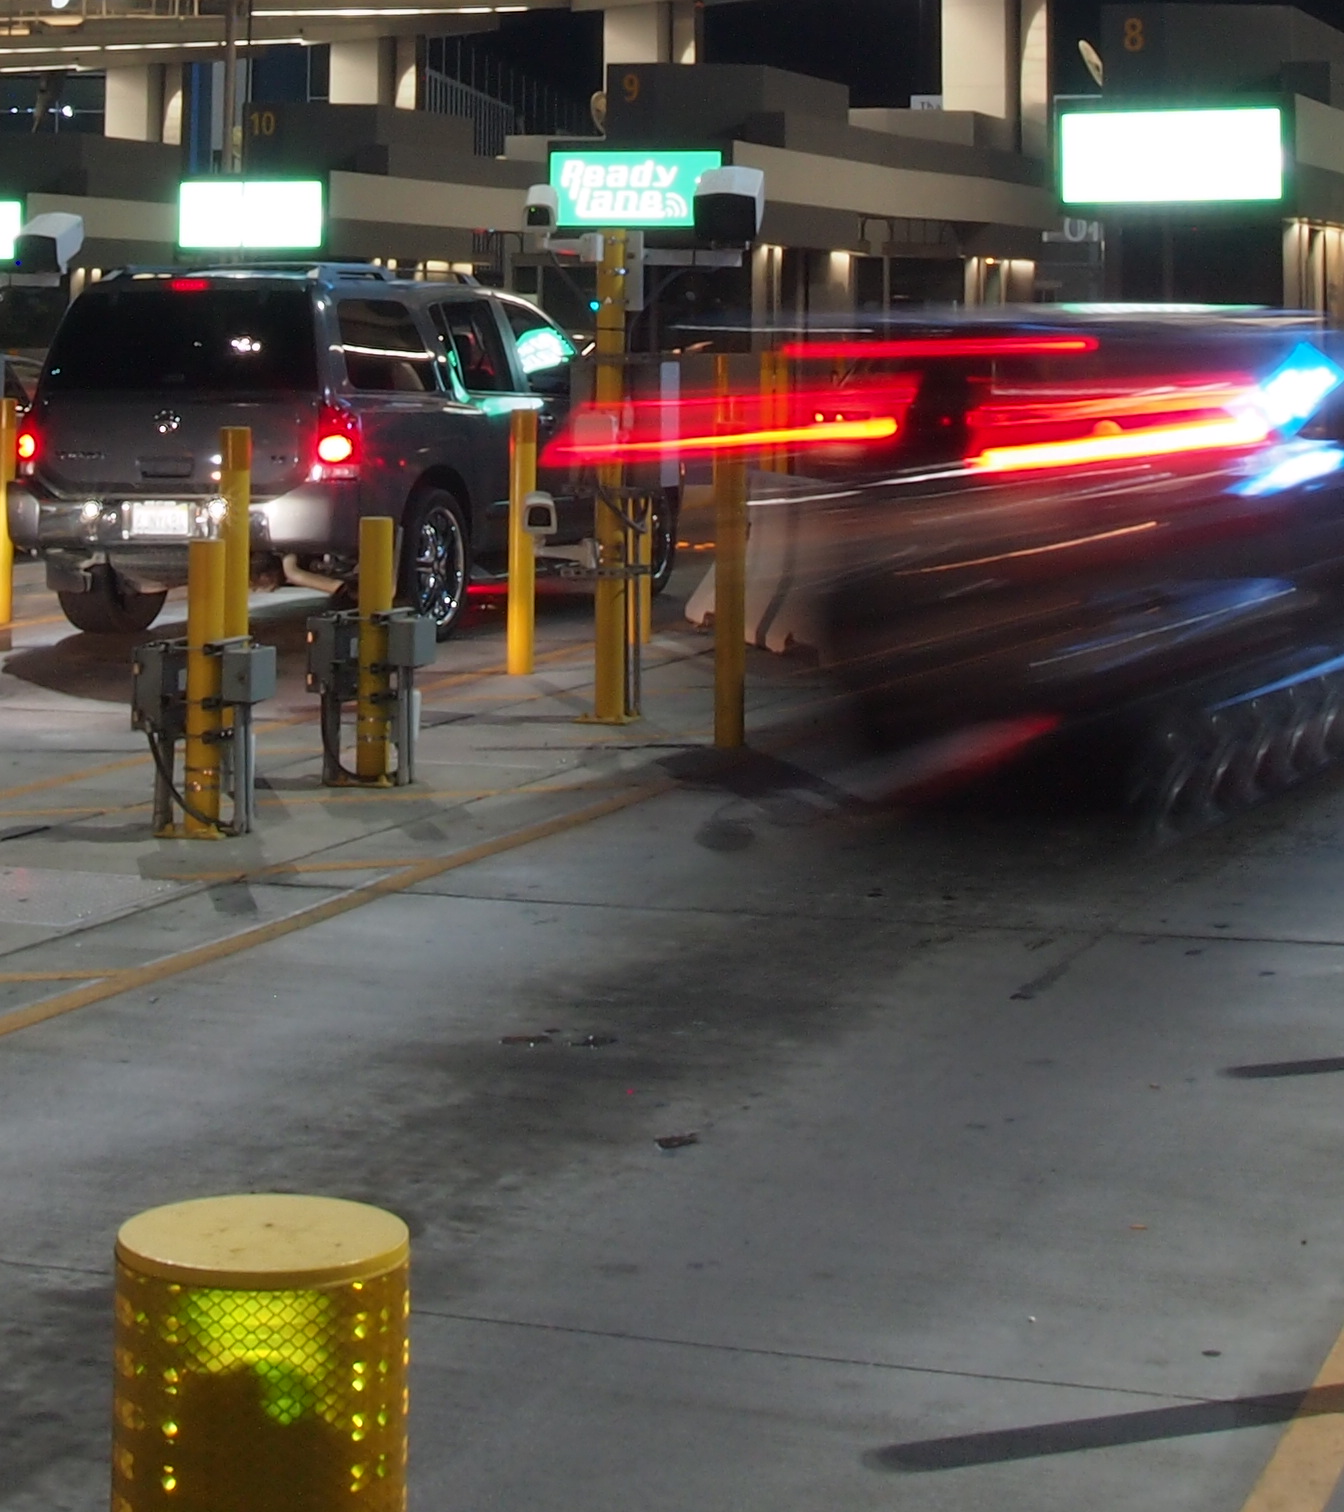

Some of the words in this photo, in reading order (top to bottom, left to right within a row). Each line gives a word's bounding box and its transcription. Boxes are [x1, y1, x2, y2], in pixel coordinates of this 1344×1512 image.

[1122, 17, 1145, 53] 8
[621, 73, 642, 102] 9
[249, 111, 276, 137] 10
[560, 159, 678, 192] Ready
